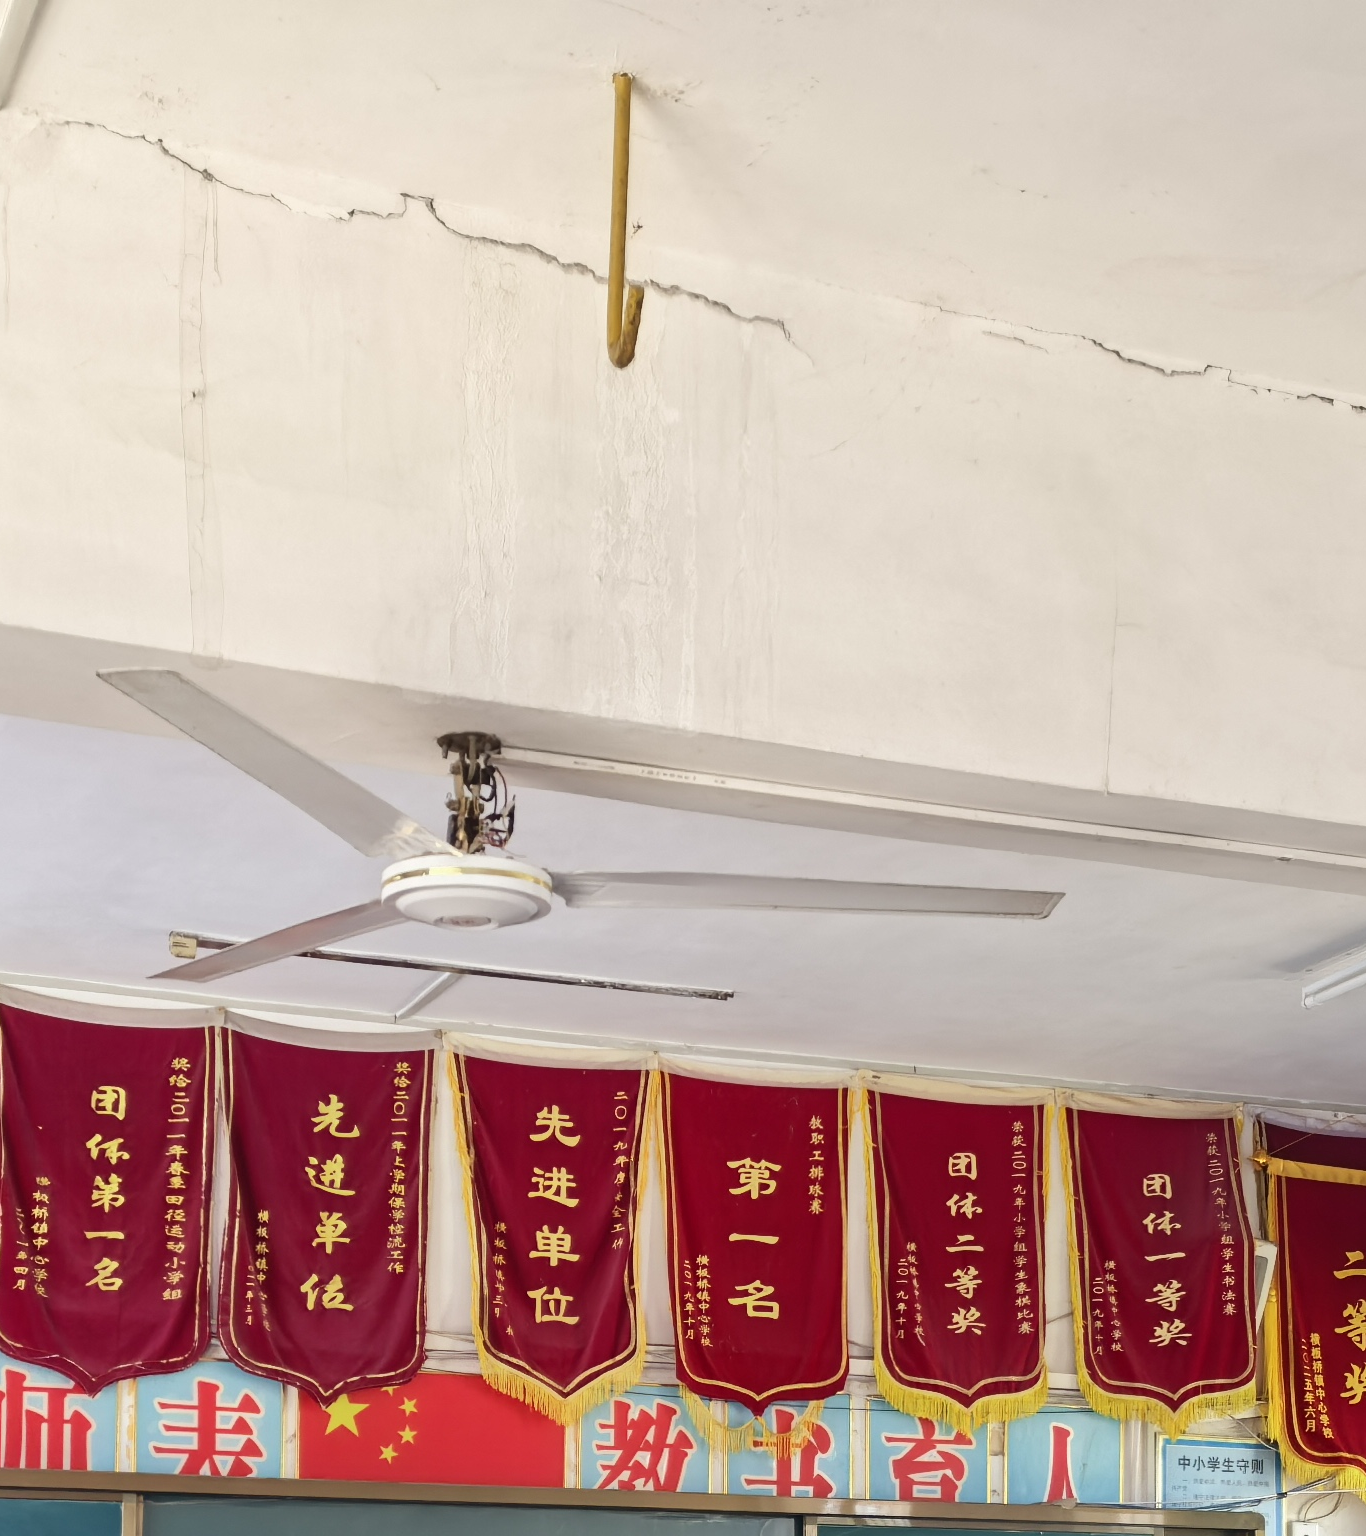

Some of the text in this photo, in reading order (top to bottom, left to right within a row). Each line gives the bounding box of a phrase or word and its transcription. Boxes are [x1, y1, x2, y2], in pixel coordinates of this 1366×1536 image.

[84, 1085, 131, 1292] 团体第一名
[300, 1093, 361, 1312] 先进单位
[526, 1104, 581, 1325] 先进单位
[726, 1156, 782, 1320] 第一名
[808, 1114, 825, 1216] 教职工排球赛
[944, 1151, 987, 1336] 团体二等奖
[1142, 1172, 1193, 1347] 团体一等奖
[1177, 1454, 1265, 1475] 中小学生守则
[1309, 1331, 1336, 1441] 横板桥镇中心学校
